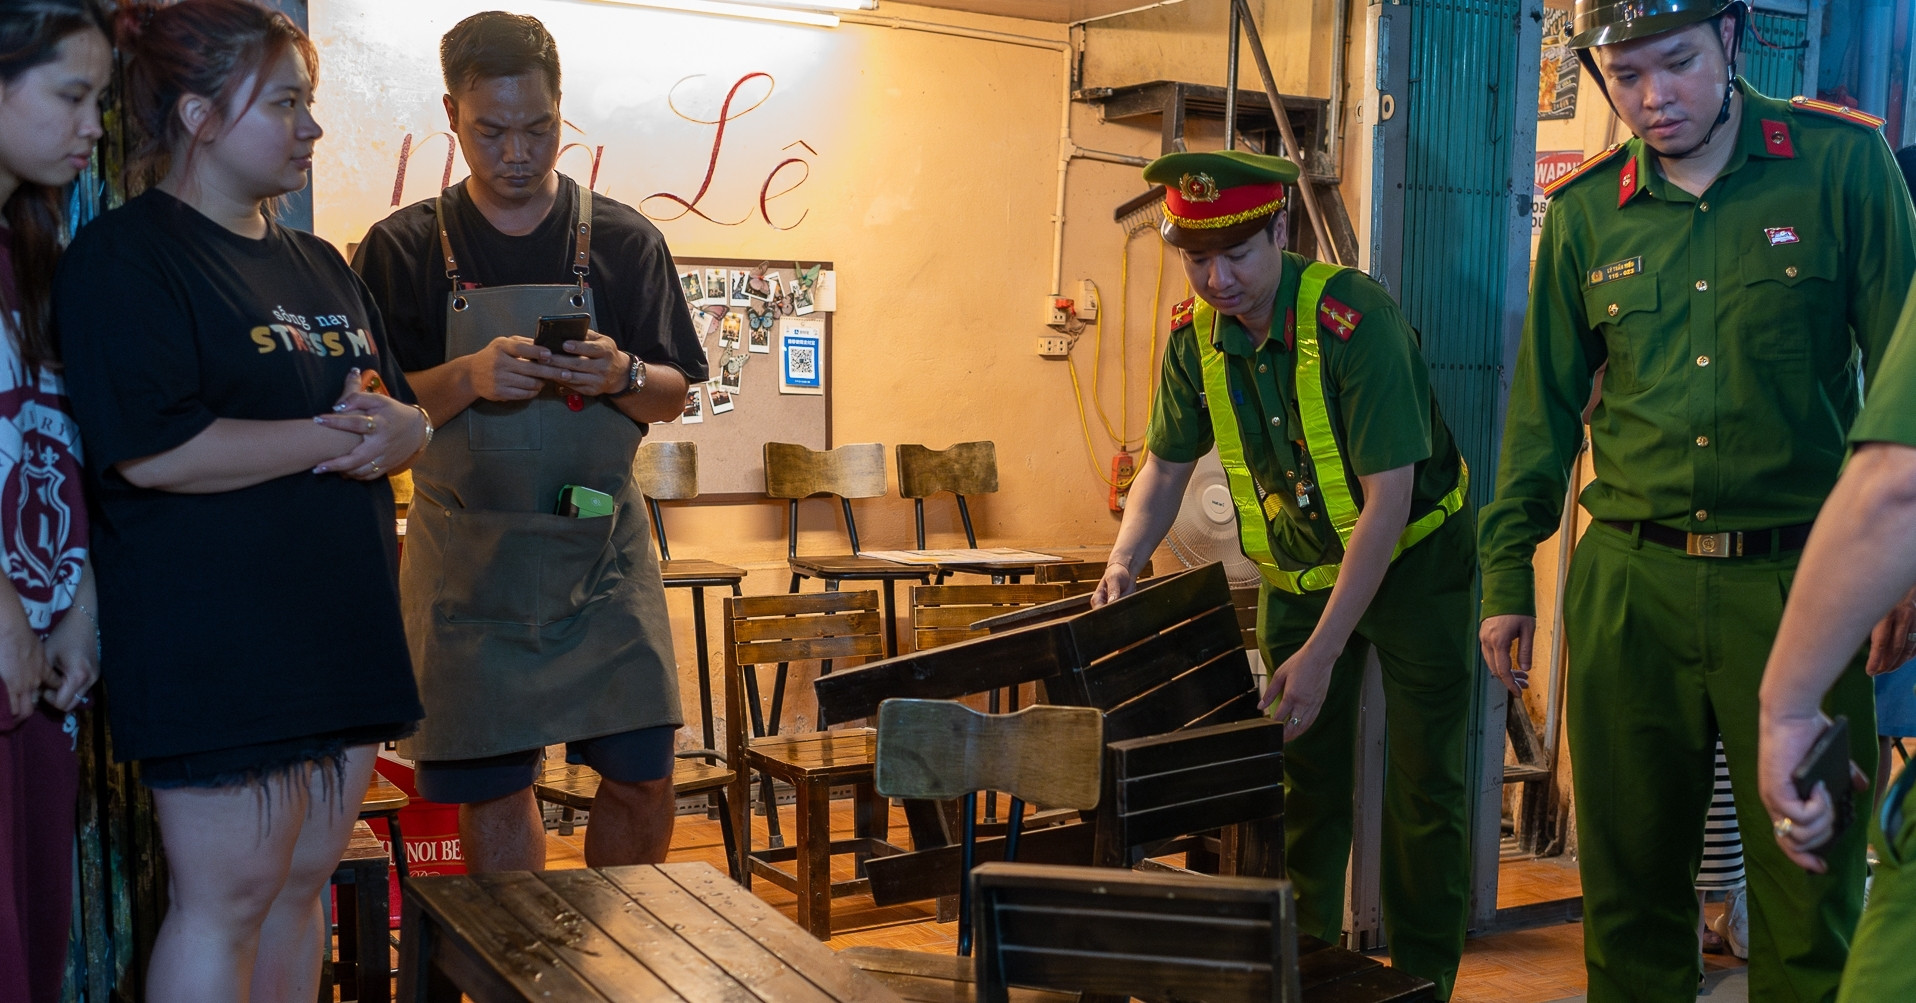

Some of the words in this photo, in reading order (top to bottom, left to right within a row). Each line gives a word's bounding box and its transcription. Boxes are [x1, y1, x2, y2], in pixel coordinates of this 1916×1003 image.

[638, 71, 819, 231] Lê
[314, 313, 350, 329] nay
[250, 324, 345, 357] STRESS
